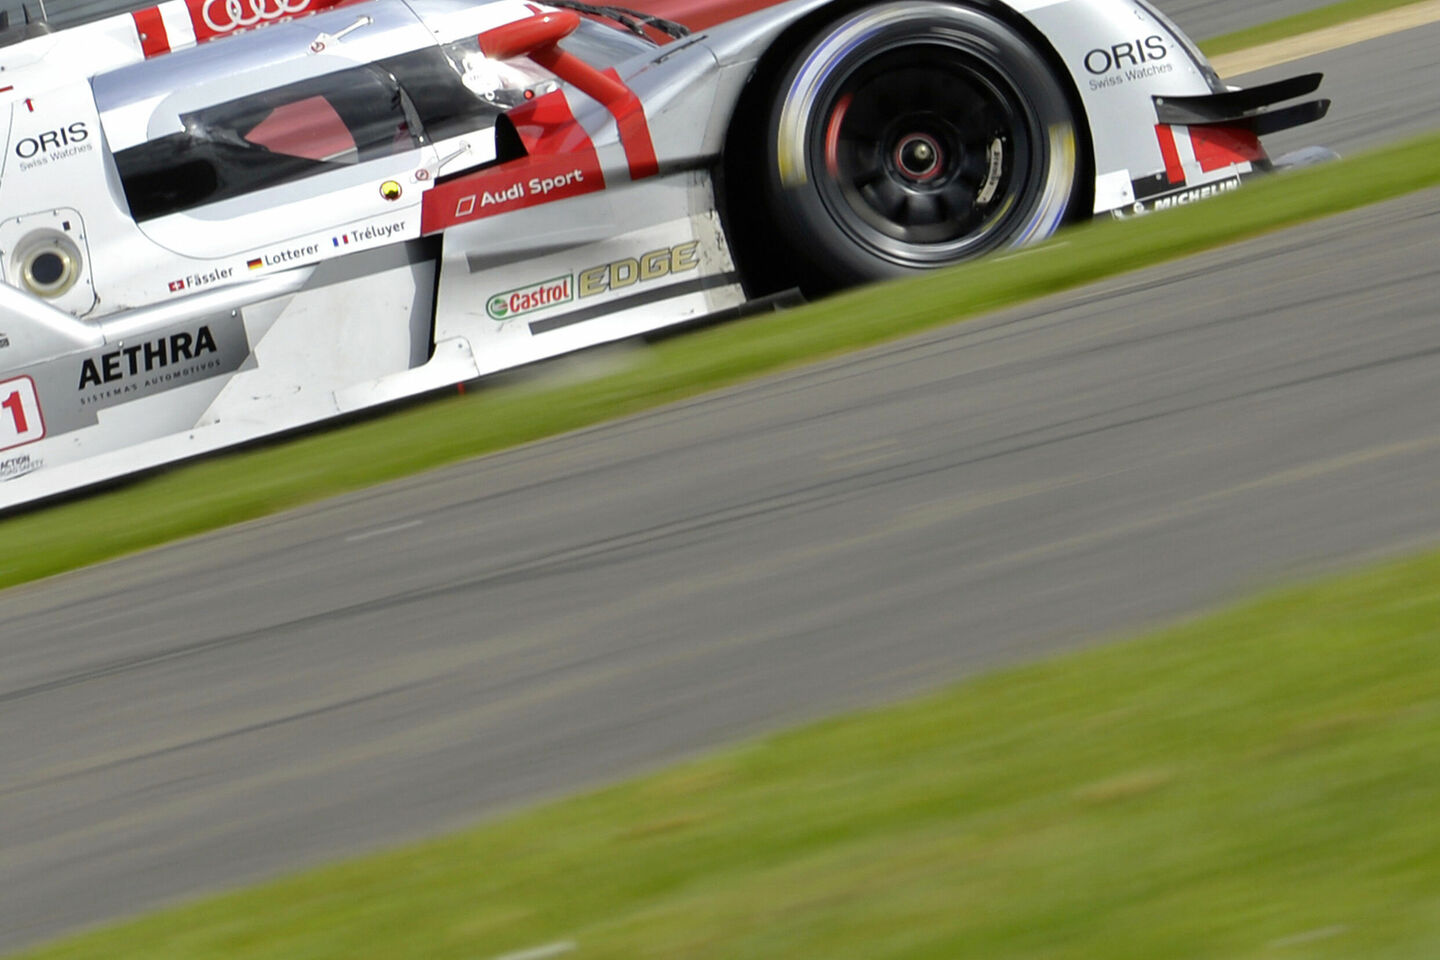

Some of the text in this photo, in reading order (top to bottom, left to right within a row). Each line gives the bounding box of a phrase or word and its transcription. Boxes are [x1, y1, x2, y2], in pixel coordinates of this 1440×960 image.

[1084, 35, 1167, 75] ORIS
[1089, 63, 1173, 91] Swiss Watches
[15, 122, 88, 159] ORIS
[19, 144, 93, 172] Swiss Watches
[481, 169, 584, 207] Audi Sport
[1154, 179, 1238, 211] MICHELIN
[186, 220, 406, 289] Fässler Lotterer Tréluyer
[509, 241, 700, 313] Castrol EDGE
[78, 325, 217, 391] AETHRA
[80, 358, 221, 405] SISTEMAS AUTOMOTIVOS
